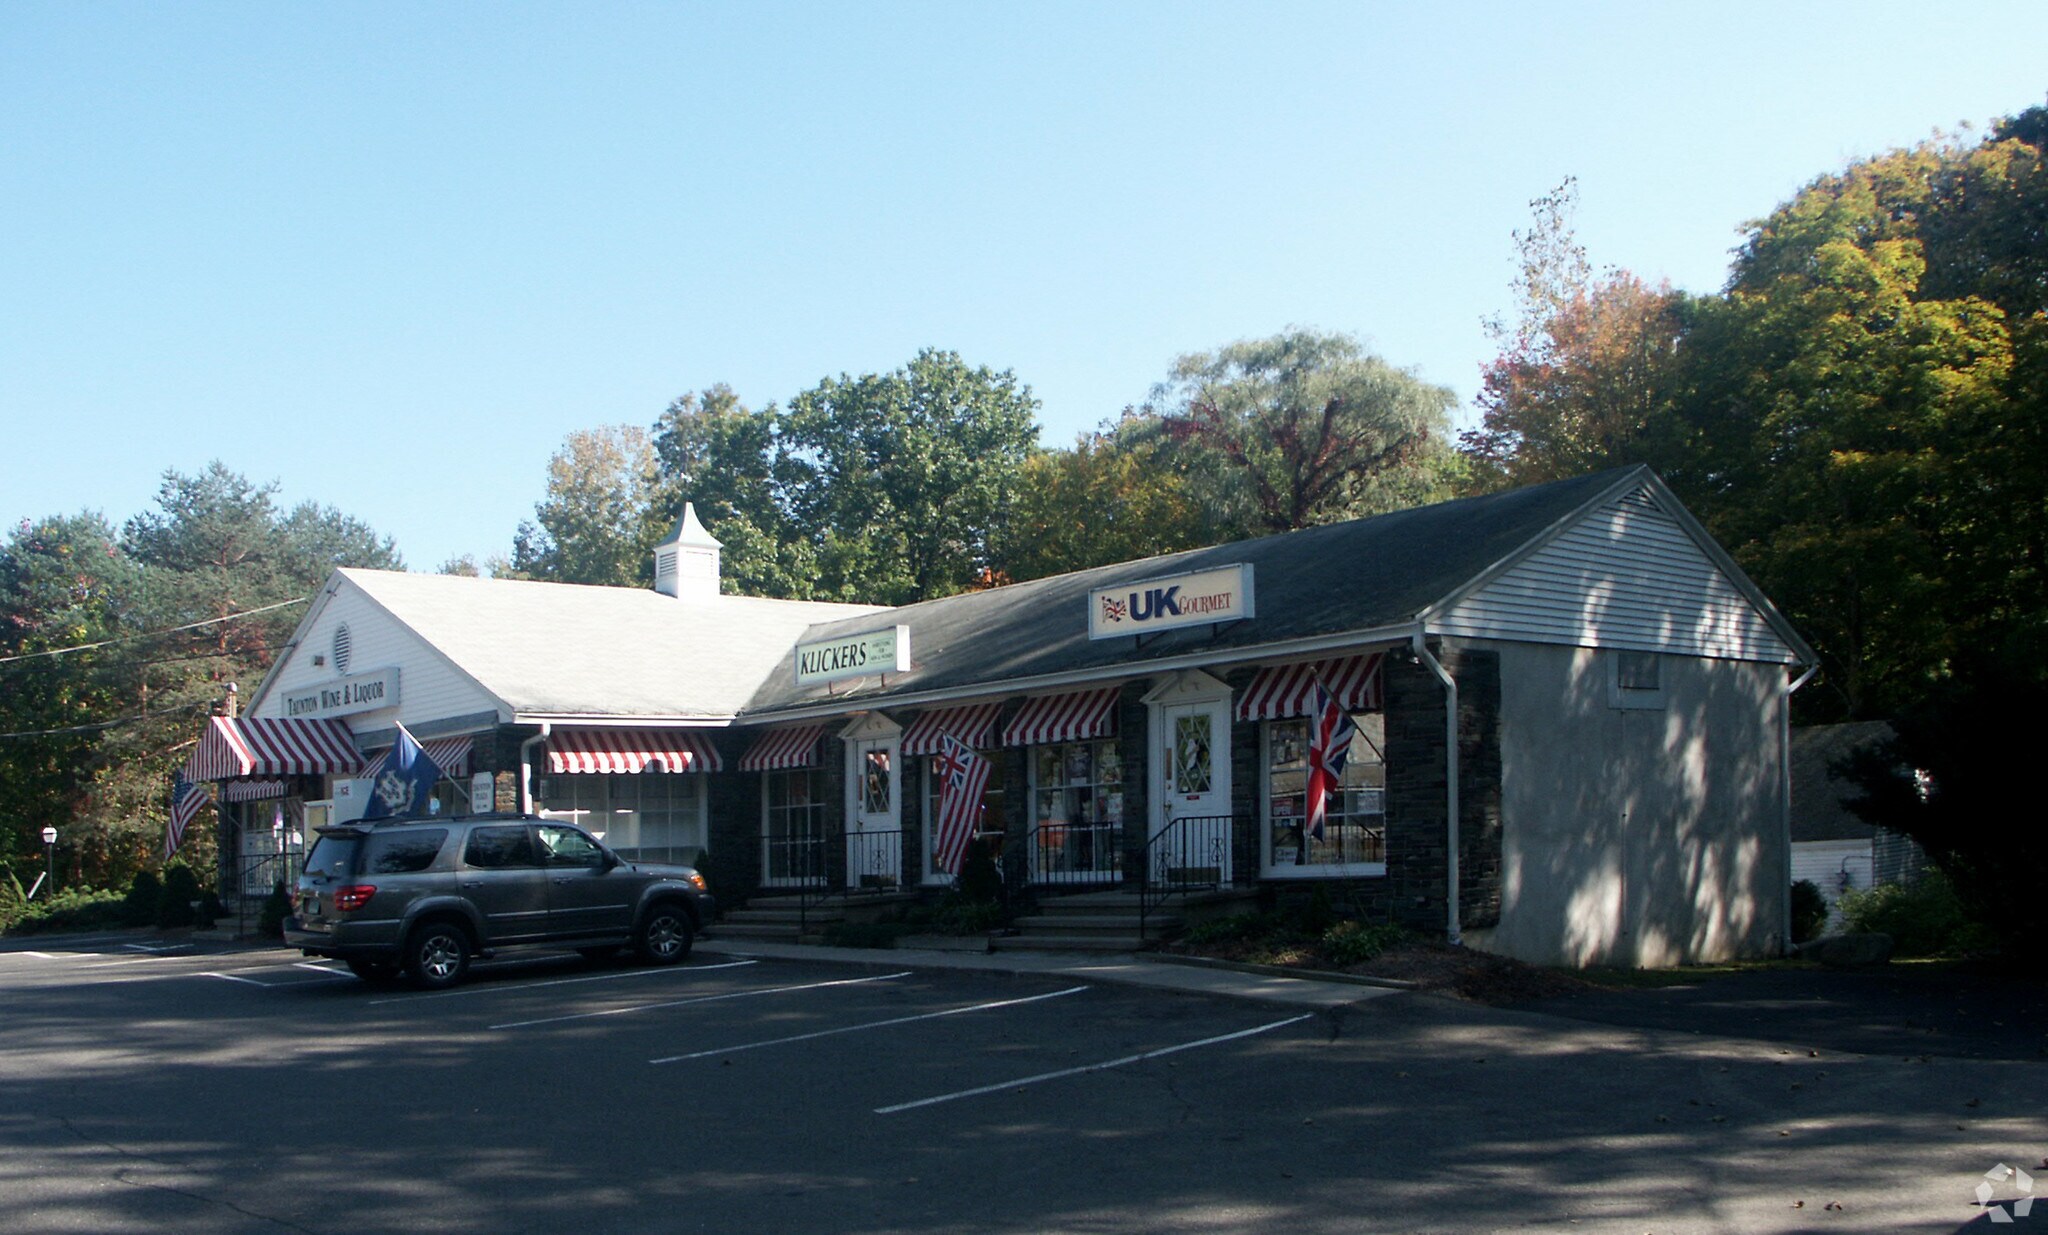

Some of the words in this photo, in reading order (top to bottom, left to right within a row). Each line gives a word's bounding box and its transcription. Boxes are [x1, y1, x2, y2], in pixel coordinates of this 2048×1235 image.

[1129, 585, 1181, 621] UK
[1179, 592, 1232, 616] GOURMET
[801, 642, 866, 675] KLICKERS
[288, 696, 318, 716] TAUNTON
[321, 690, 341, 709] WINE
[344, 685, 351, 705] &
[354, 681, 384, 704] LIQUOR
